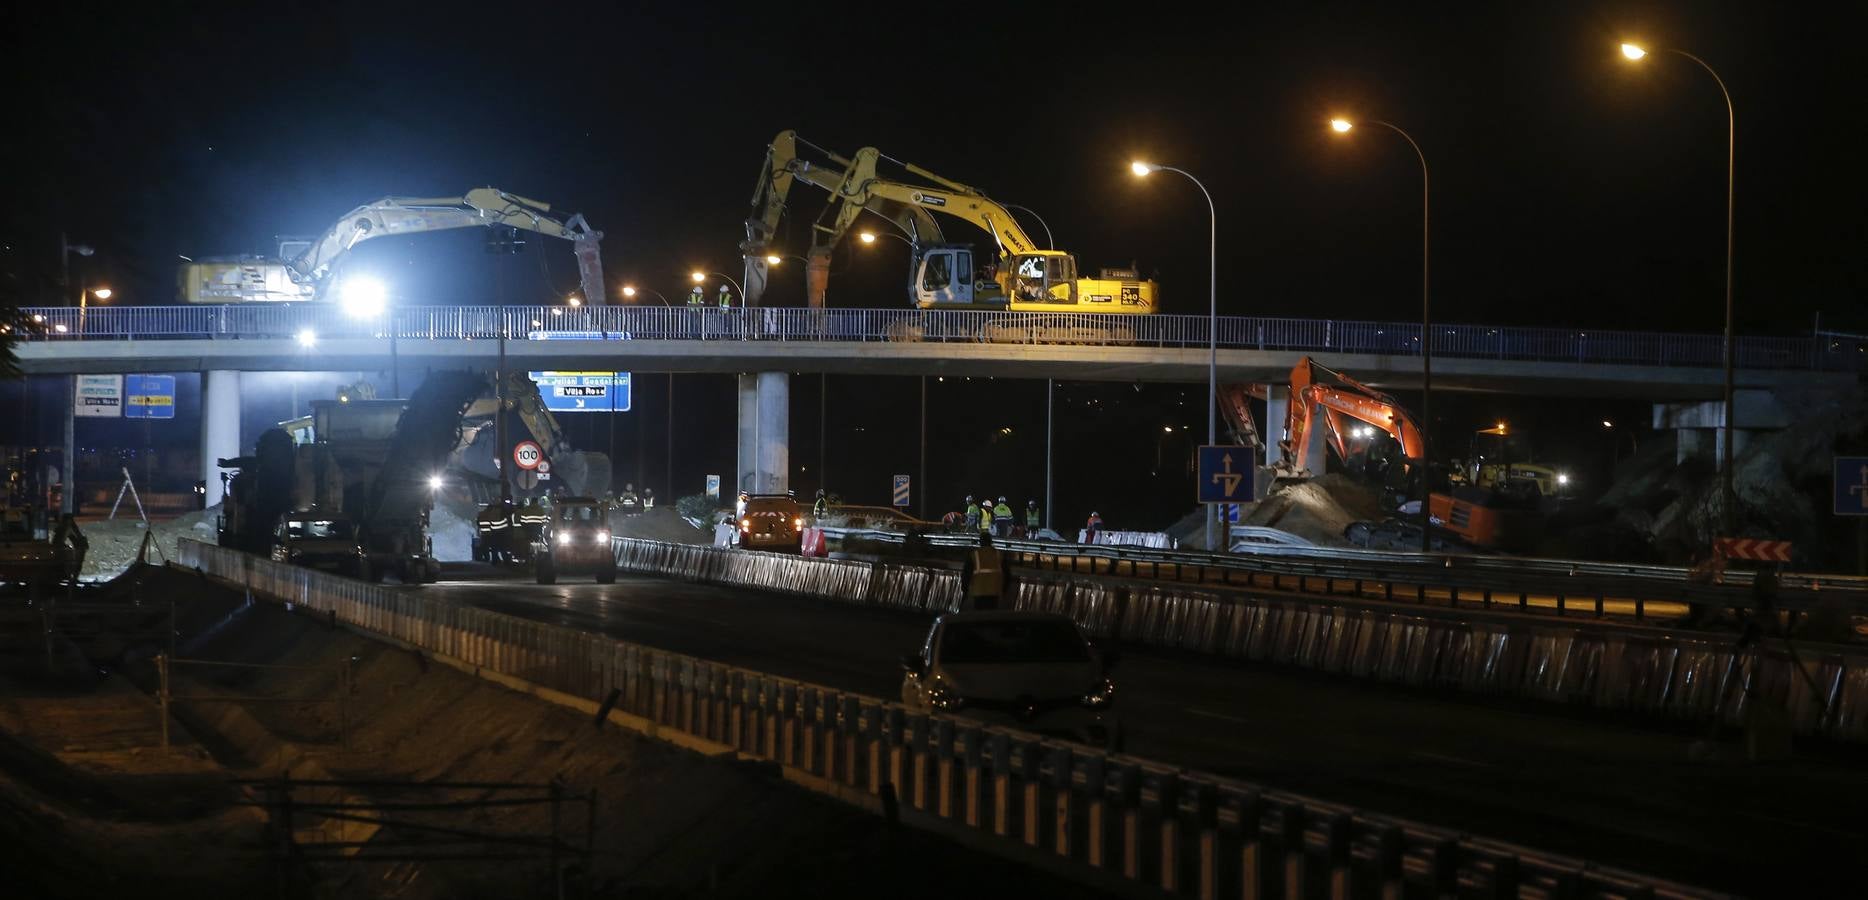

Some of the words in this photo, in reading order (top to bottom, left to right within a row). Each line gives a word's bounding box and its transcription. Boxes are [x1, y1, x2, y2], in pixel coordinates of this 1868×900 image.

[1004, 230, 1026, 252] KOMATS
[565, 388, 583, 396] Villa
[585, 388, 605, 396] Rosa
[519, 450, 538, 460] 100
